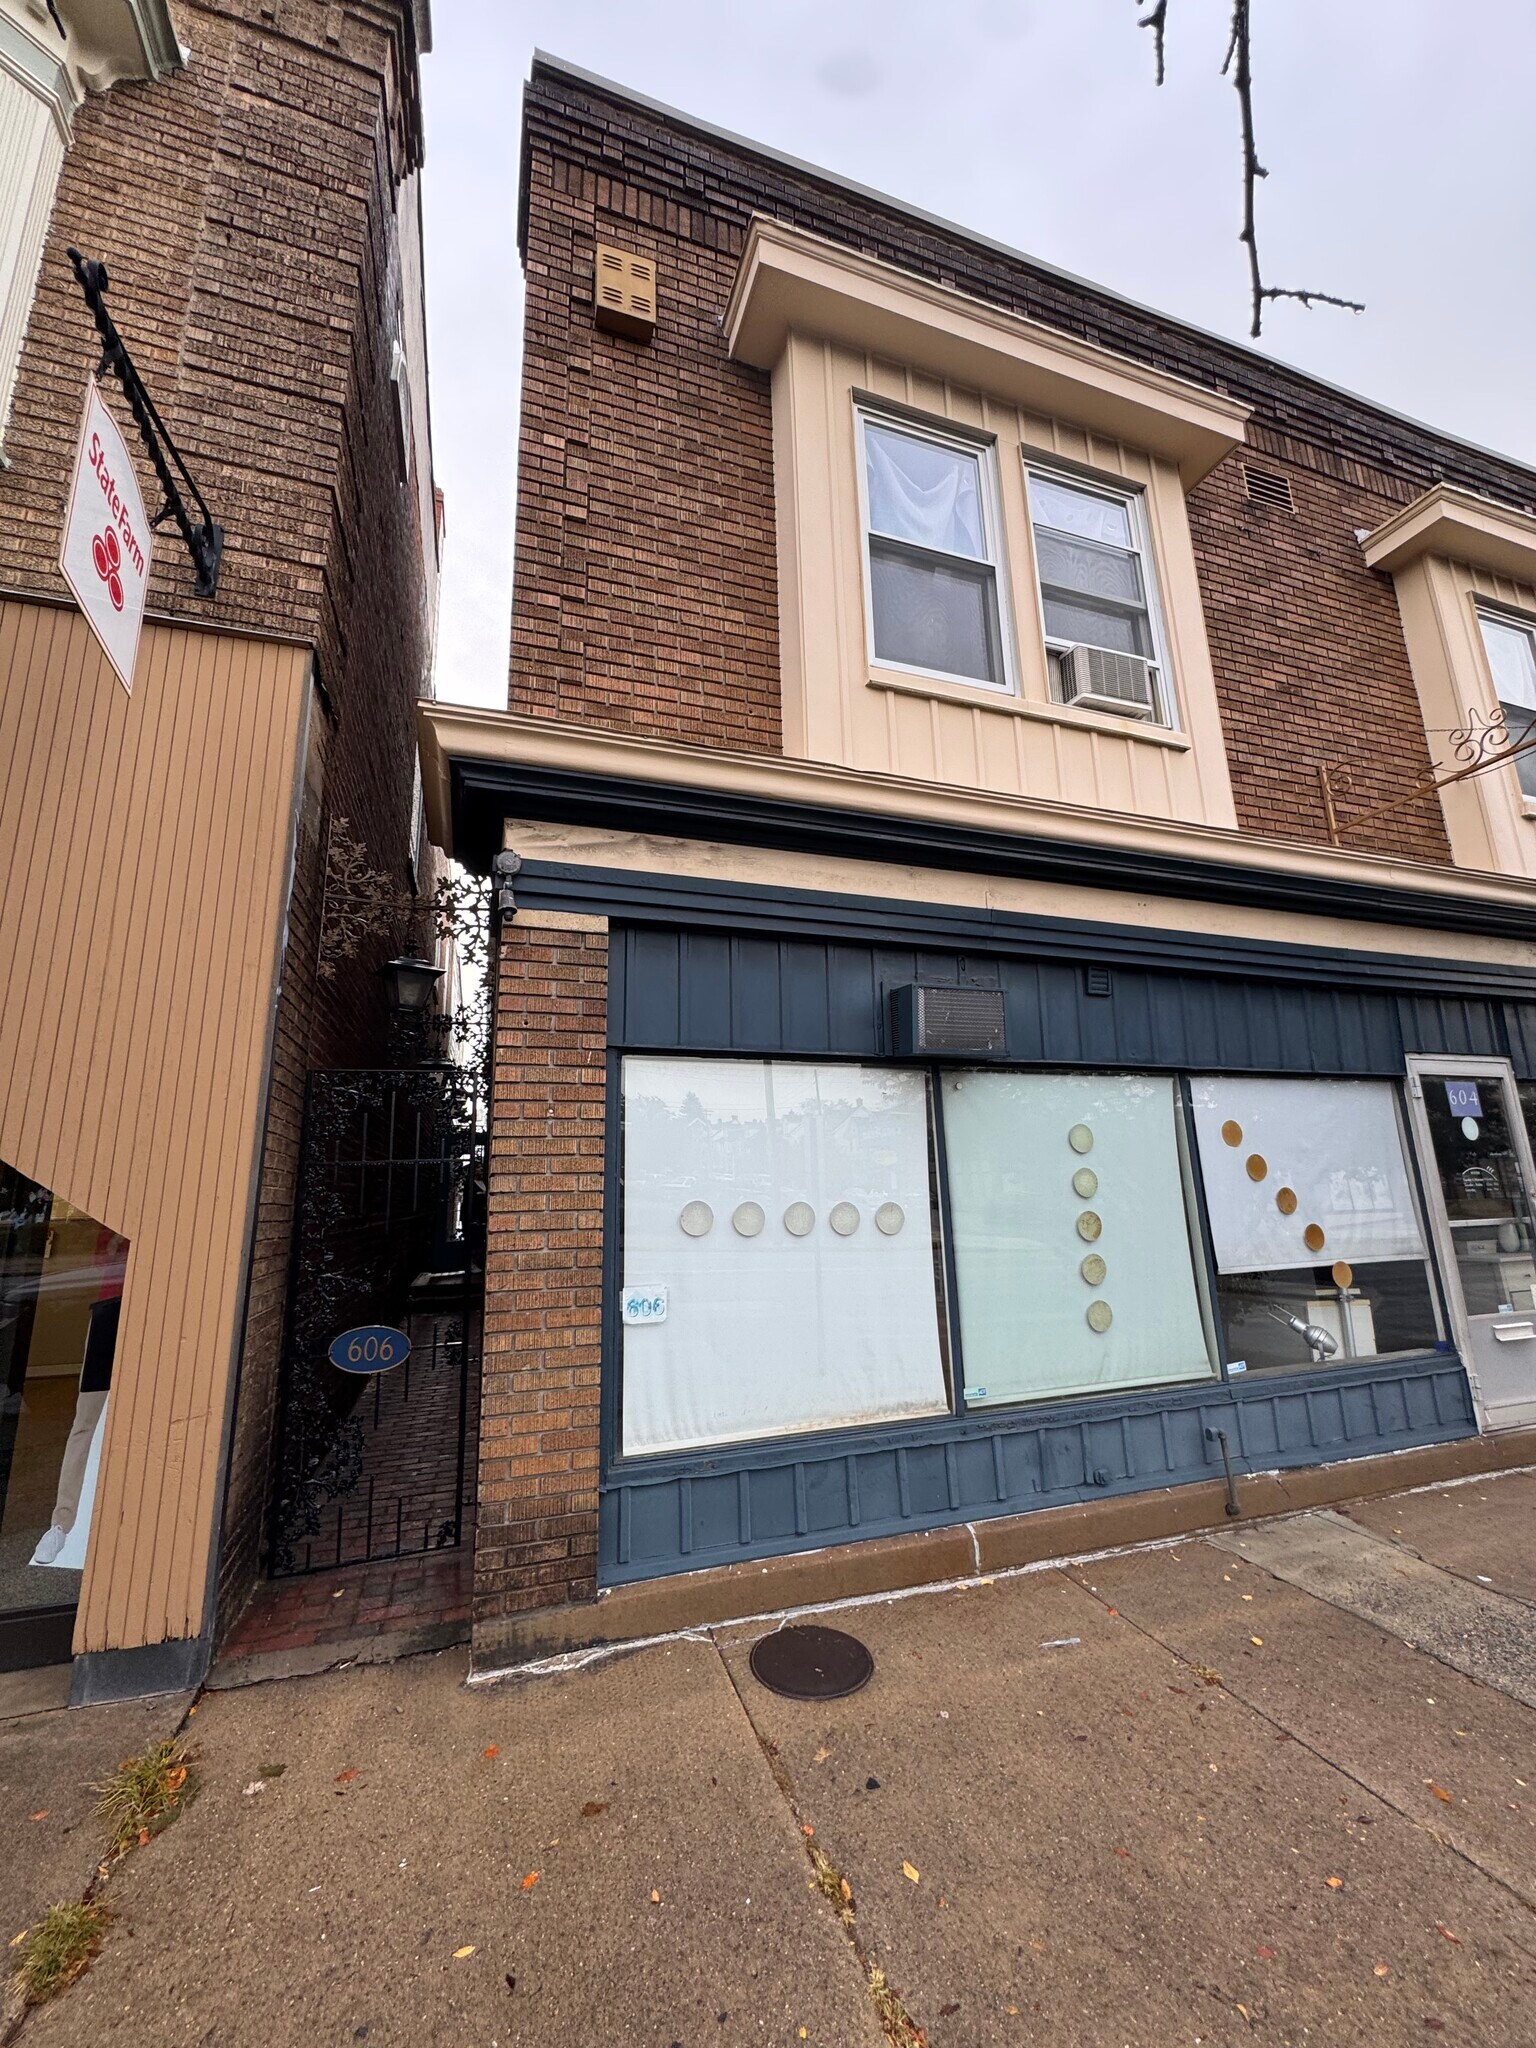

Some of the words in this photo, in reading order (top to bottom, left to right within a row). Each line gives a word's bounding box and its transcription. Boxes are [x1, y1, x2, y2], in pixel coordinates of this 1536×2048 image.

[1449, 1089, 1479, 1106] 604
[626, 1296, 666, 1318] 606
[347, 1335, 394, 1363] 606
